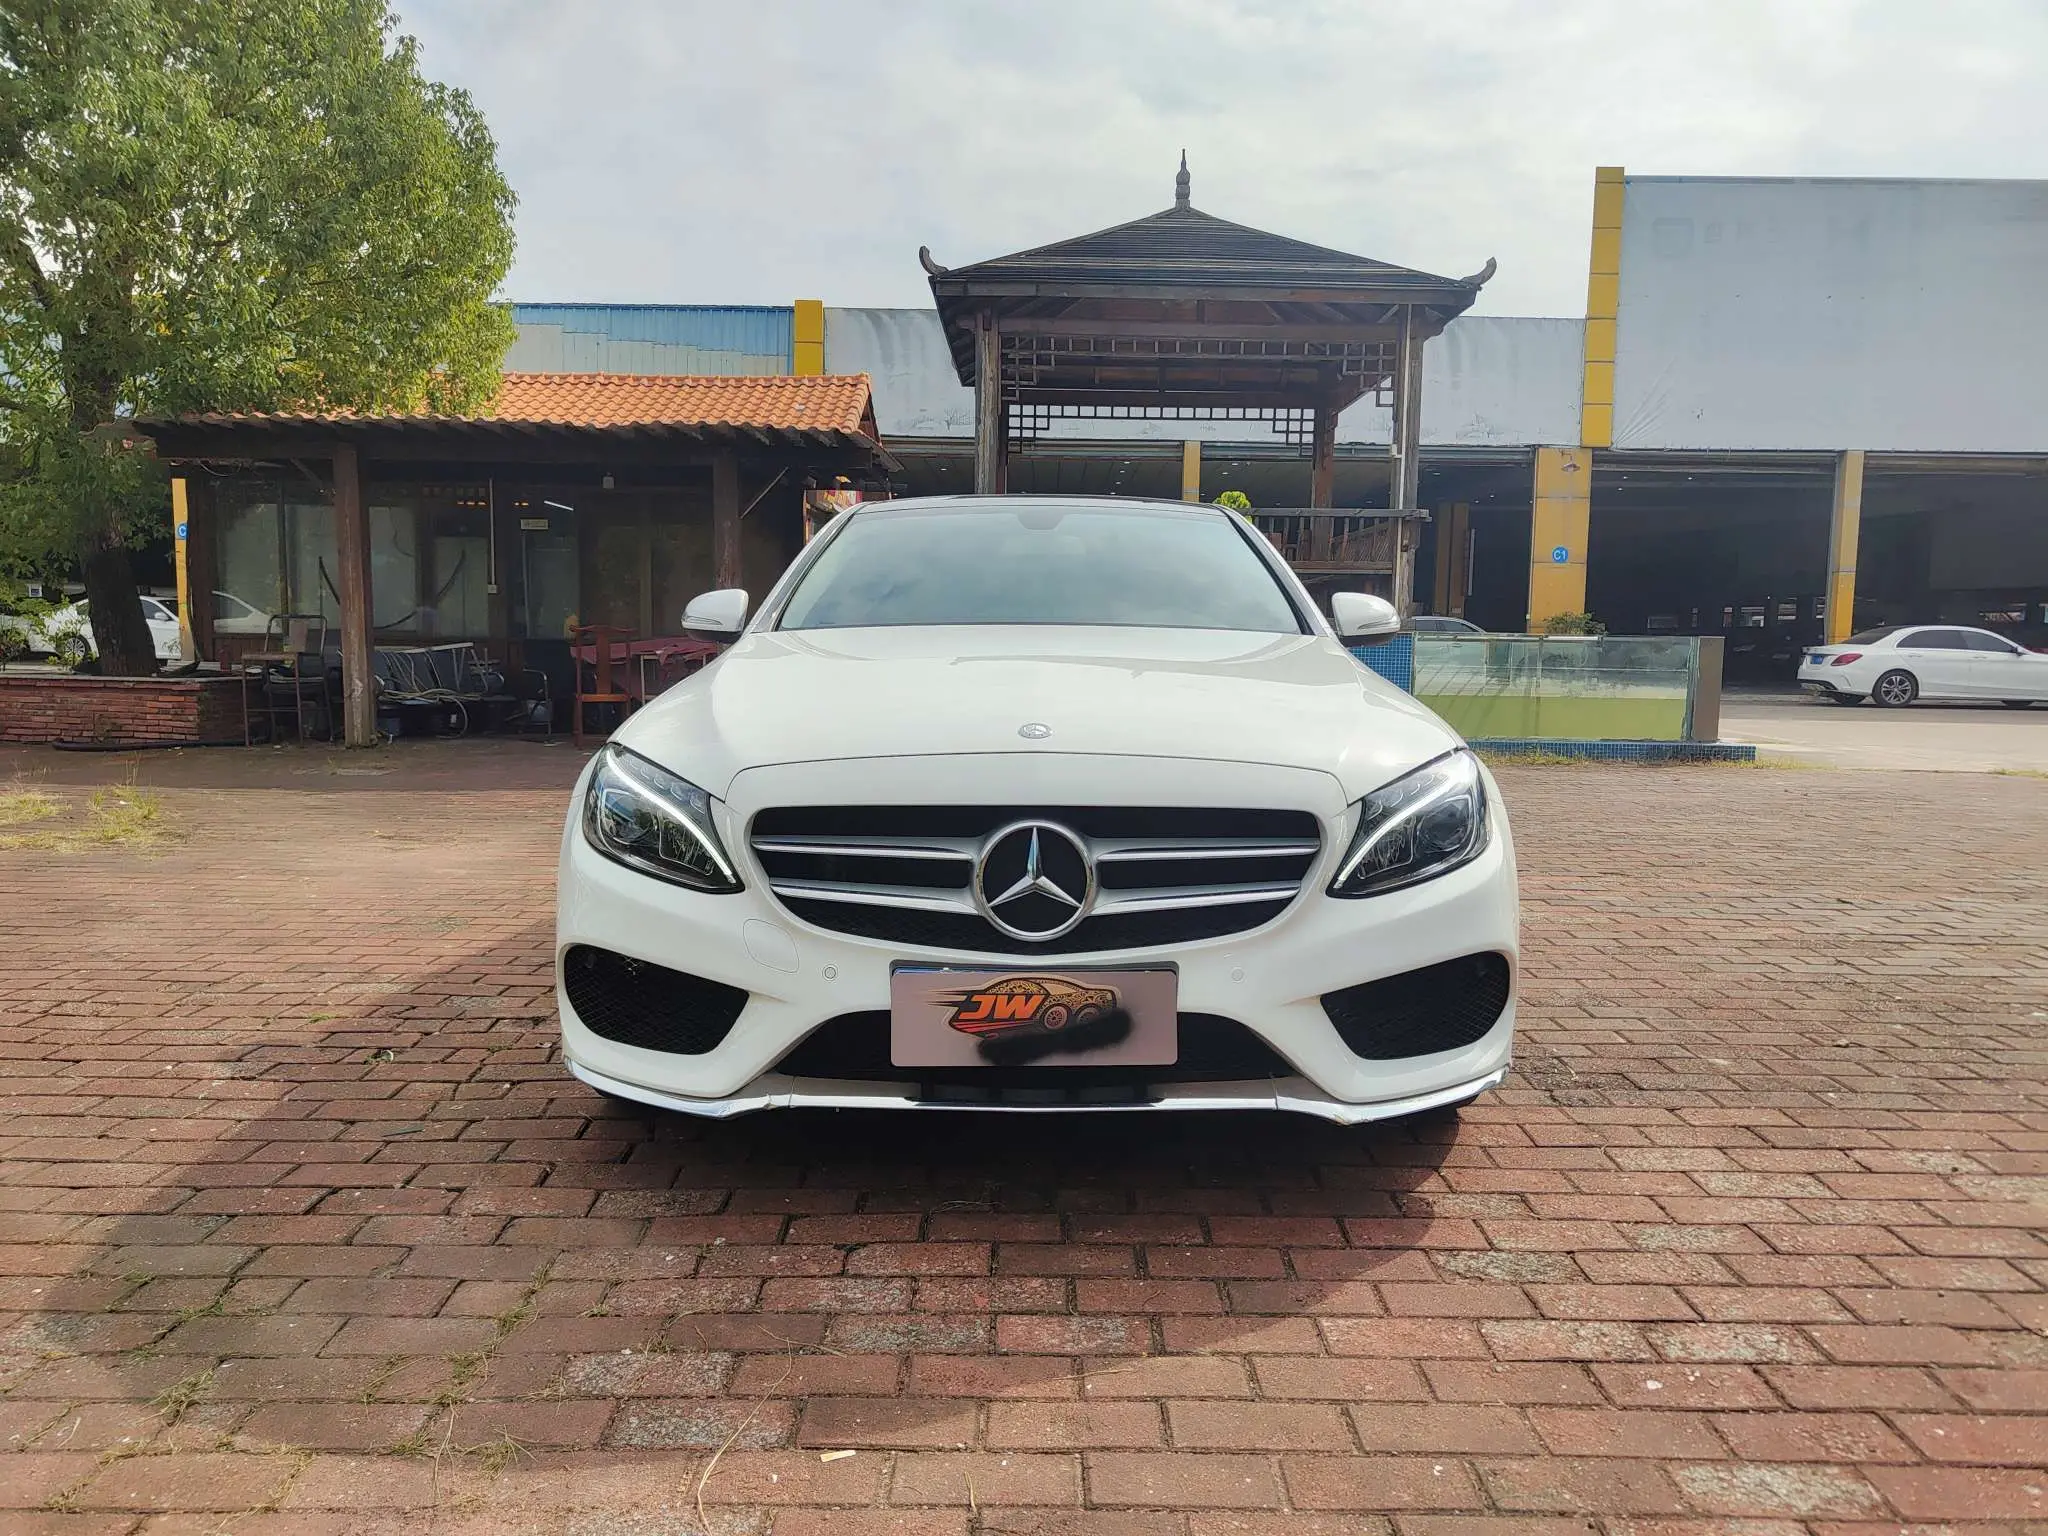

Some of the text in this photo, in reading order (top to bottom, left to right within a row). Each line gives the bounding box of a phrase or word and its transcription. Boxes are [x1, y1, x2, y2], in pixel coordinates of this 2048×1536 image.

[179, 525, 187, 537] C
[1553, 549, 1566, 560] C1
[959, 994, 1045, 1019] JW
